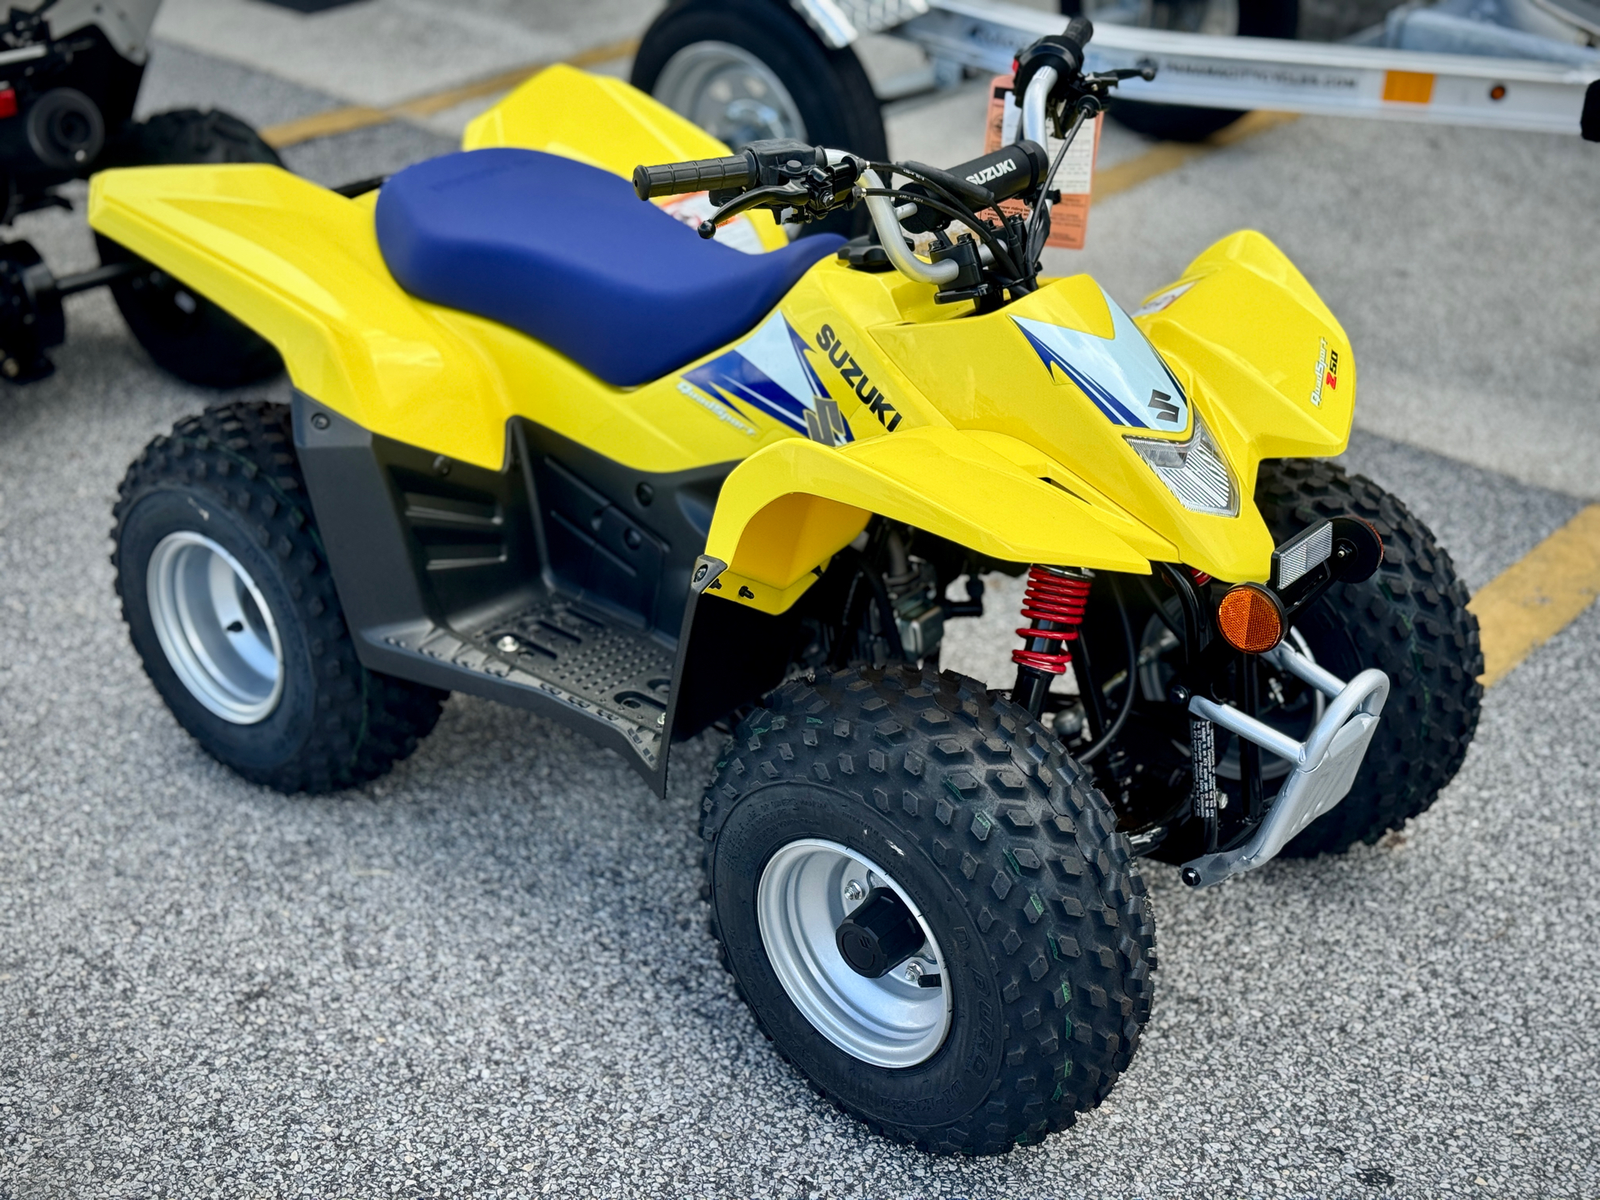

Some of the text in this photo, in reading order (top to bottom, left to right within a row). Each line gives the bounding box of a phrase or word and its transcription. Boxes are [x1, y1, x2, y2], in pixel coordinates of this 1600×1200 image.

[965, 158, 1017, 185] SUZUKI
[815, 323, 903, 432] SUZUKI
[1310, 337, 1328, 408] QuadSport
[1325, 349, 1338, 390] Z50
[676, 381, 757, 436] QuadSport
[970, 967, 994, 1078] DURO
